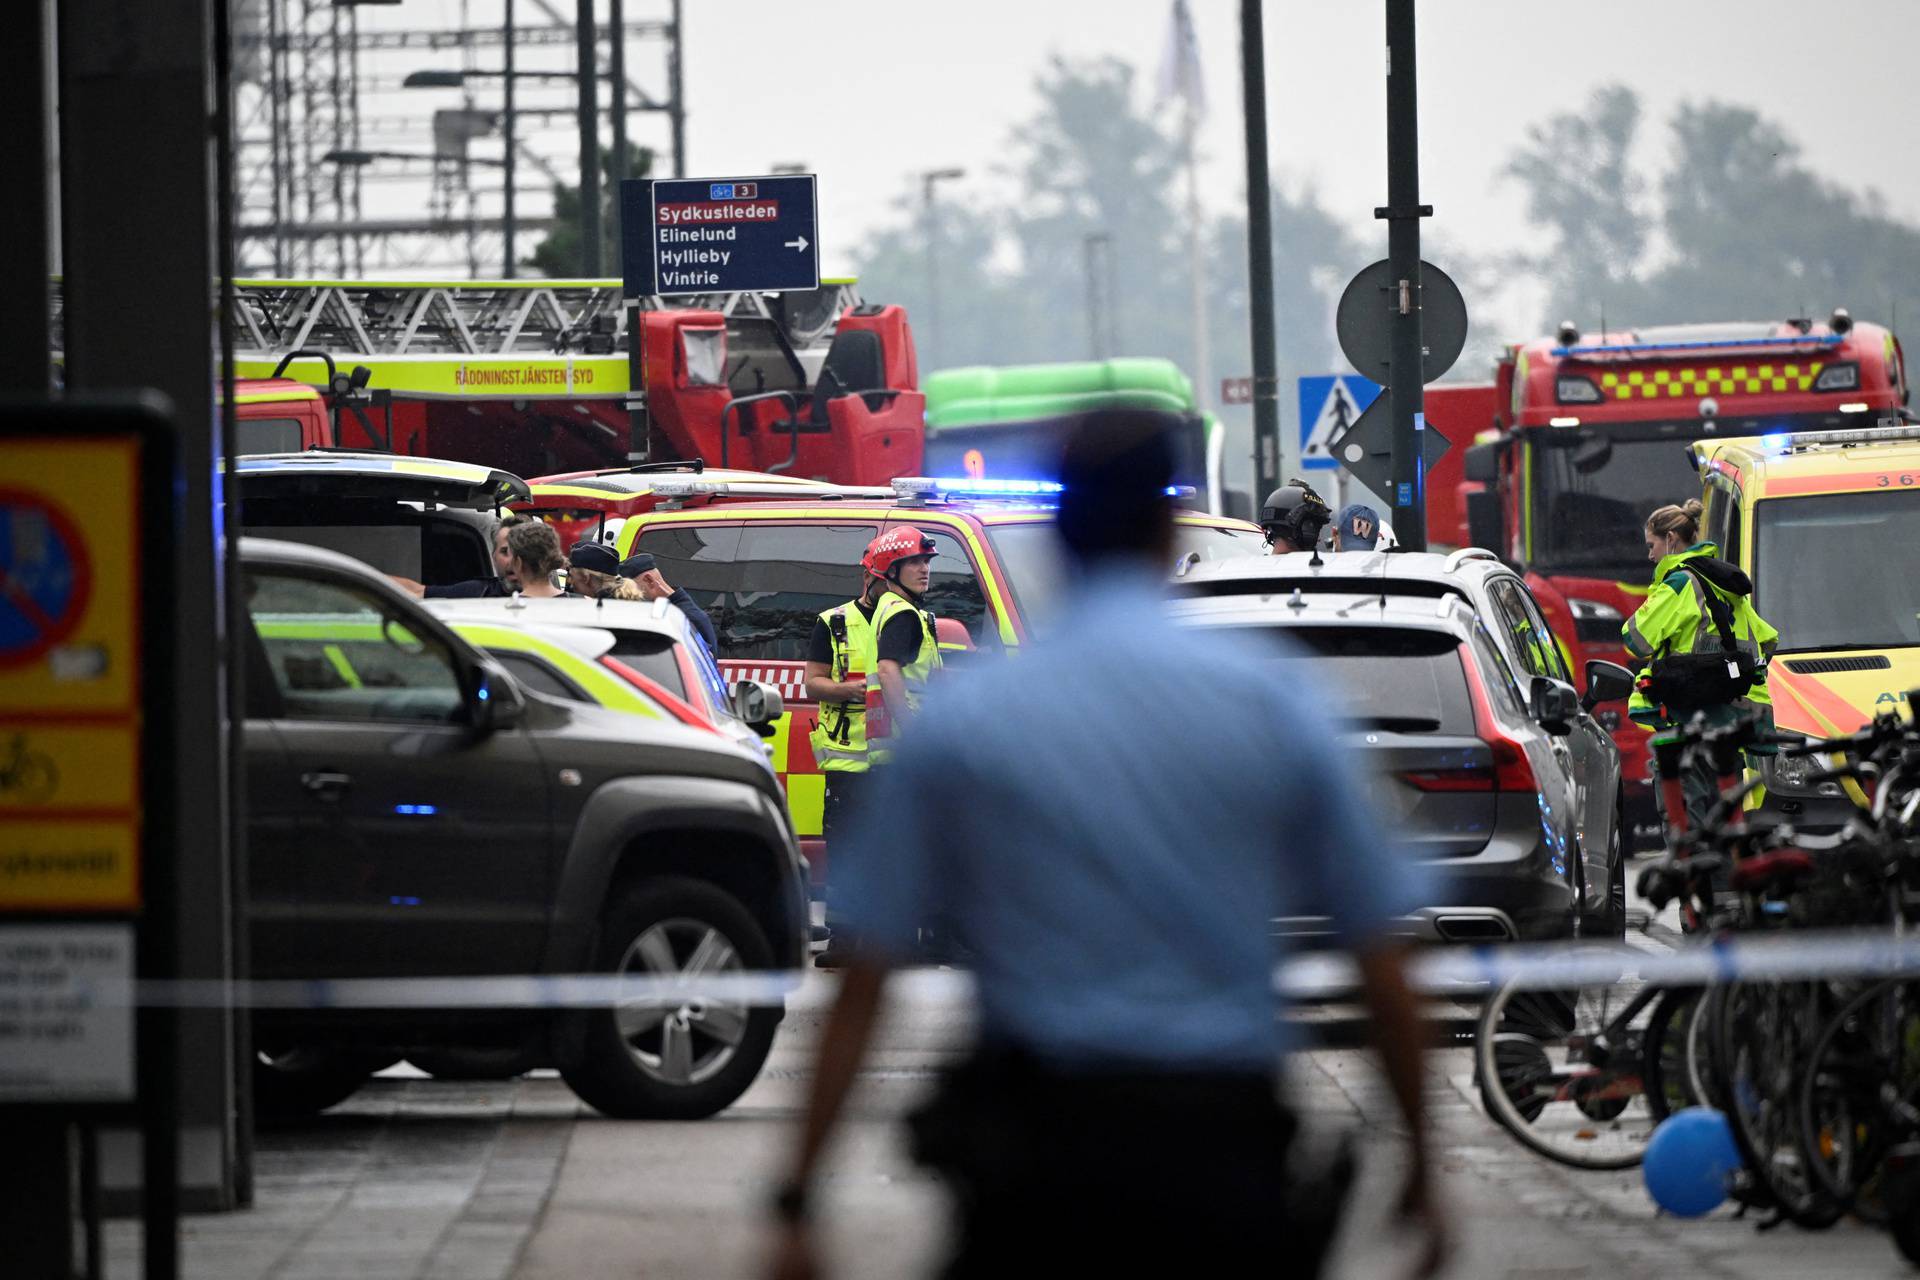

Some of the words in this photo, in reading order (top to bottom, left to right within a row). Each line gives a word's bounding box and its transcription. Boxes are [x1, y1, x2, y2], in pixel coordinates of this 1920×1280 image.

[741, 186, 749, 196] 3
[659, 204, 777, 224] Sydkustleden
[660, 226, 736, 243] Elinelund
[661, 248, 731, 267] Hyllieby
[662, 270, 720, 286] Vintrie
[573, 368, 594, 384] SYD
[1352, 517, 1372, 538] W
